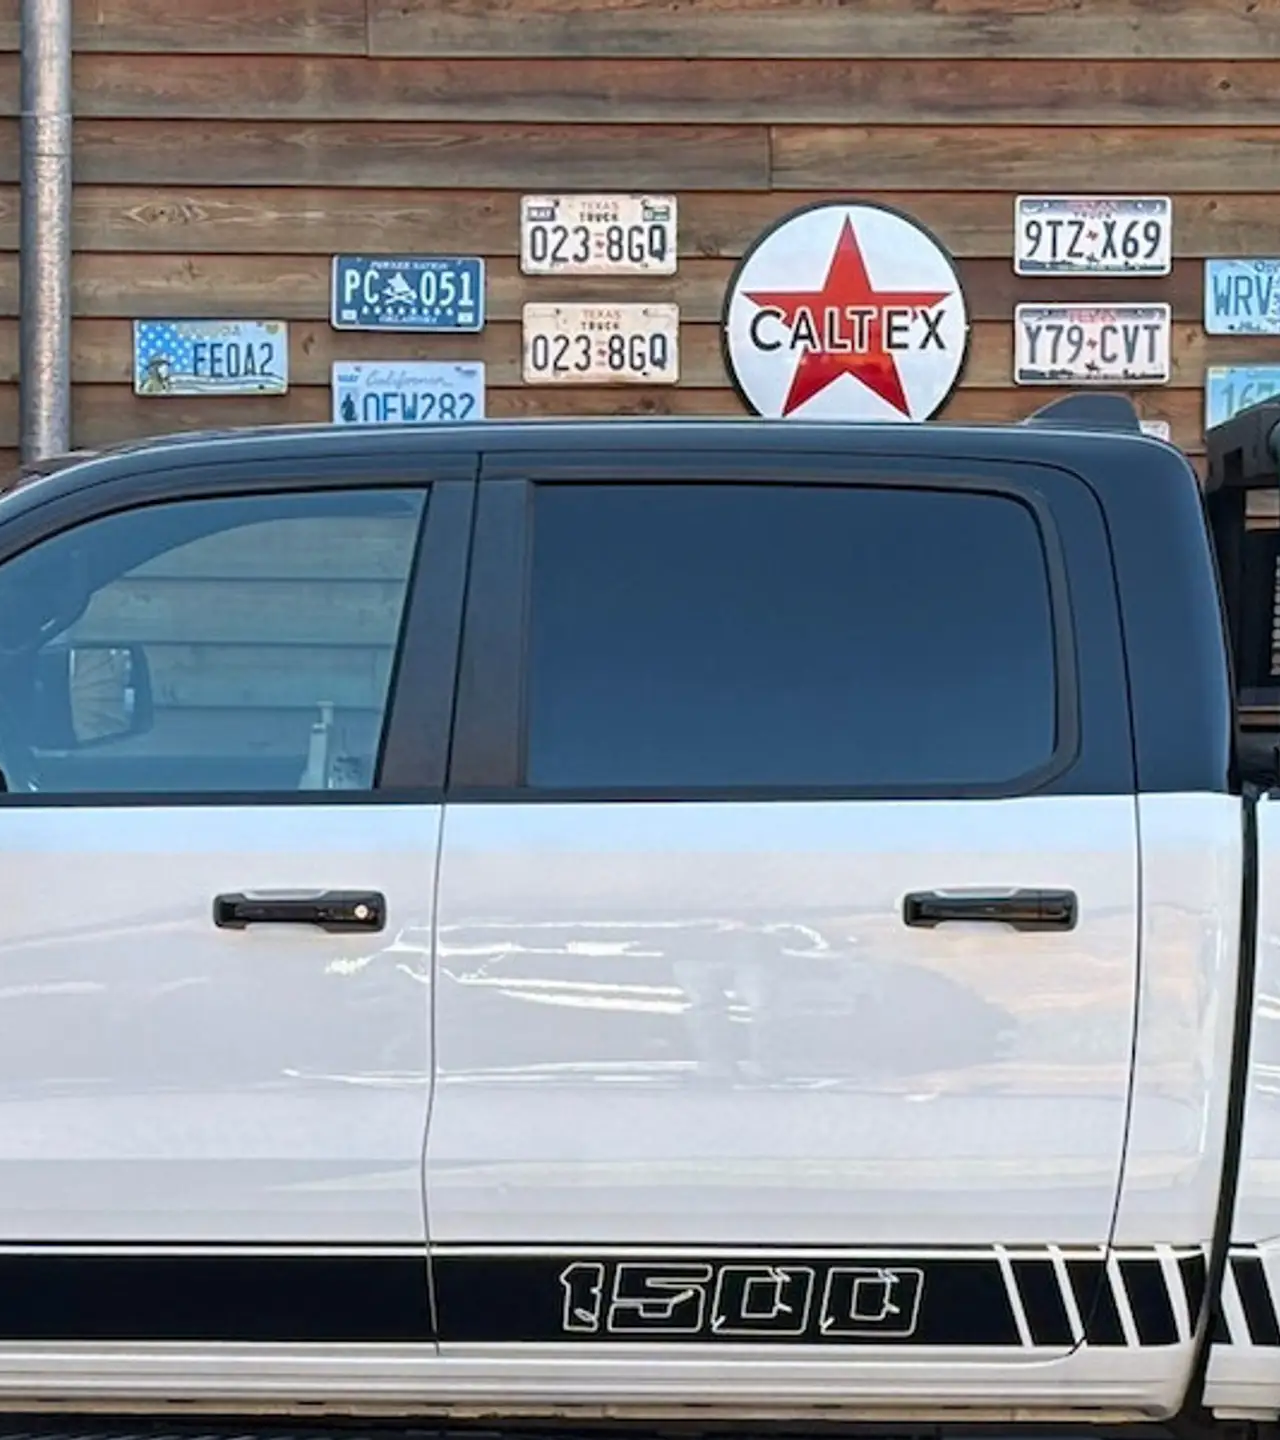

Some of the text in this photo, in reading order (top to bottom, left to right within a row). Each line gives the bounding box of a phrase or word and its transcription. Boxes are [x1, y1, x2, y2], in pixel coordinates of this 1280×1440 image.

[530, 225, 667, 262] 023 8GQ
[1025, 220, 1162, 258] 9TZ X69
[344, 269, 474, 306] PC 051
[1213, 275, 1272, 316] WRV
[748, 307, 947, 352] CALTEX
[1025, 325, 1161, 364] Y79 CVT
[532, 333, 667, 371] 023 8GQ
[561, 1262, 925, 1337] 1500
